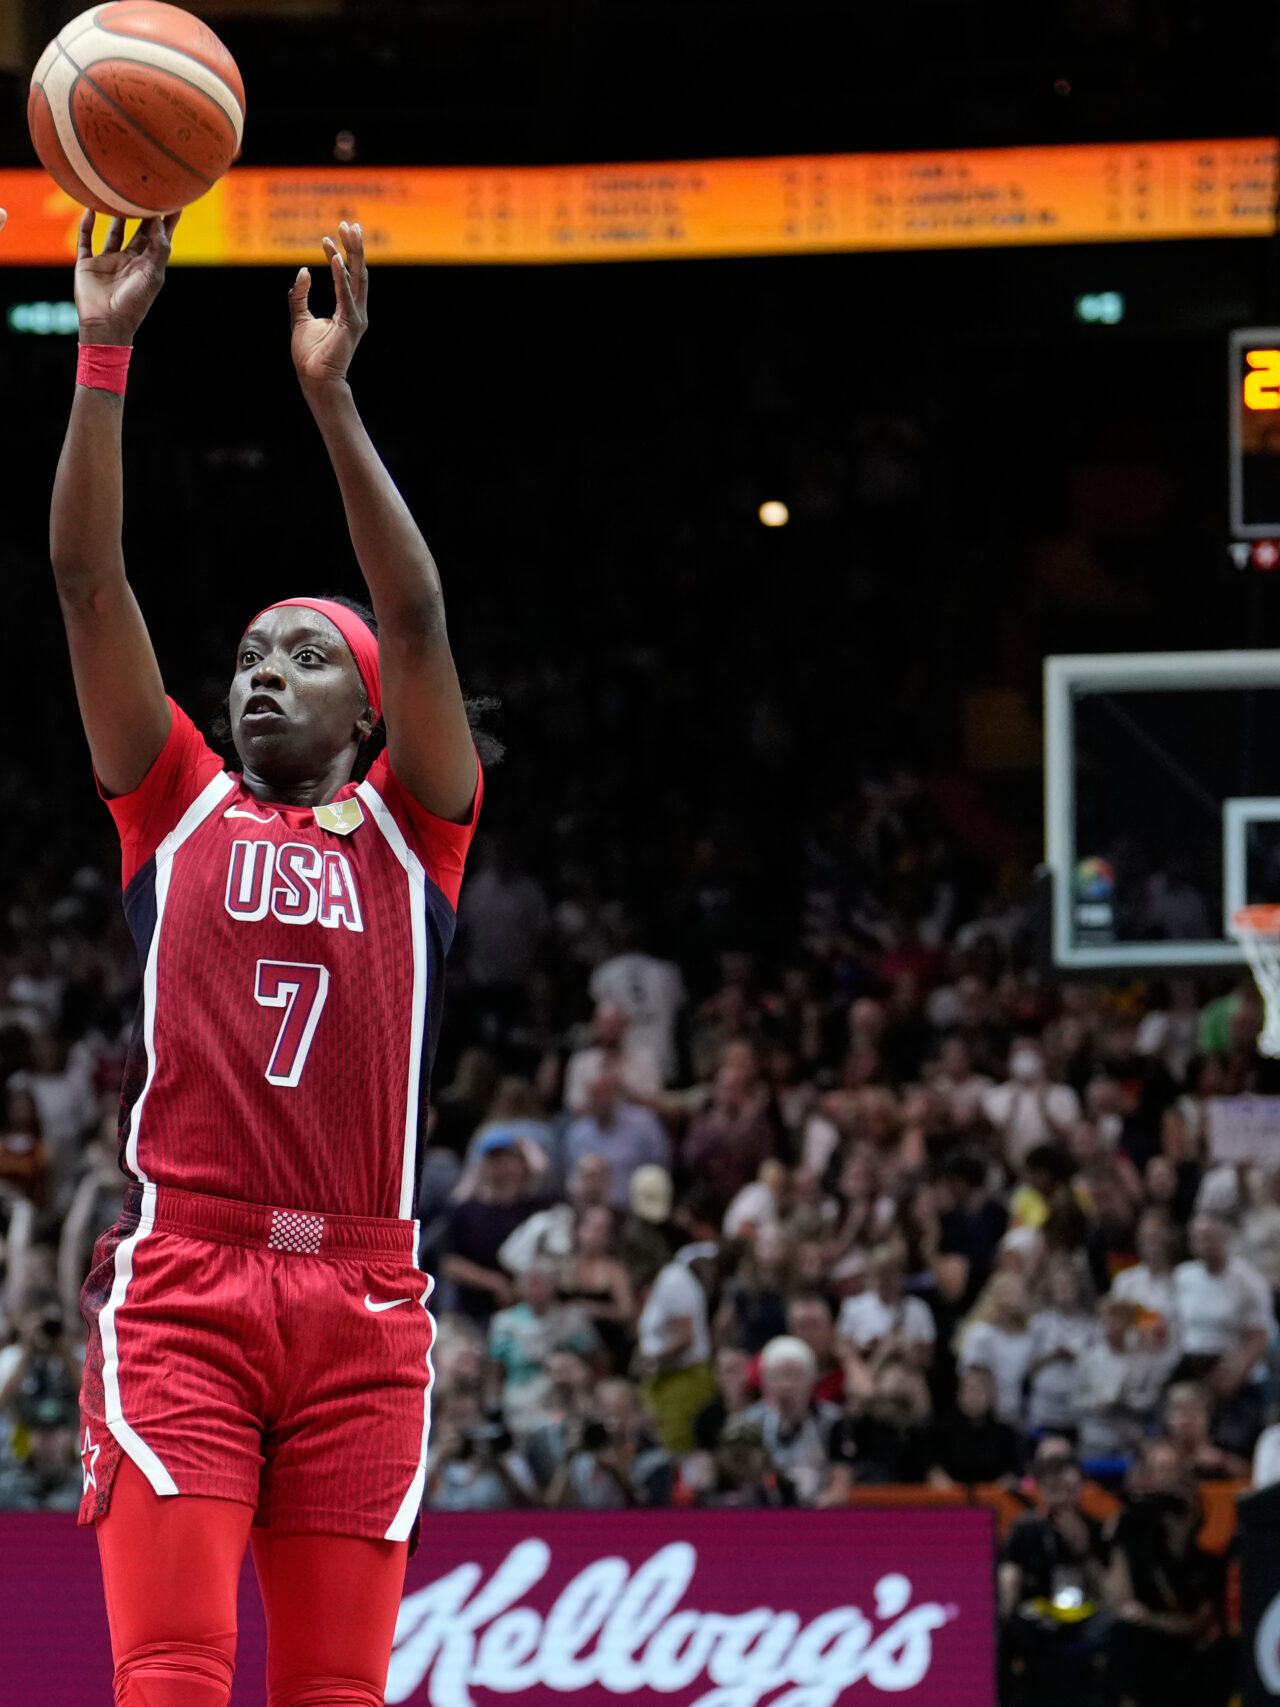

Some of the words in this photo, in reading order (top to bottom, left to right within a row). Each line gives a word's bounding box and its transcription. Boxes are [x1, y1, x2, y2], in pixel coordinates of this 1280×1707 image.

[1243, 349, 1280, 410] 2
[225, 839, 363, 932] USA
[254, 958, 331, 1088] 7
[383, 1537, 949, 1707] Kellogg's
